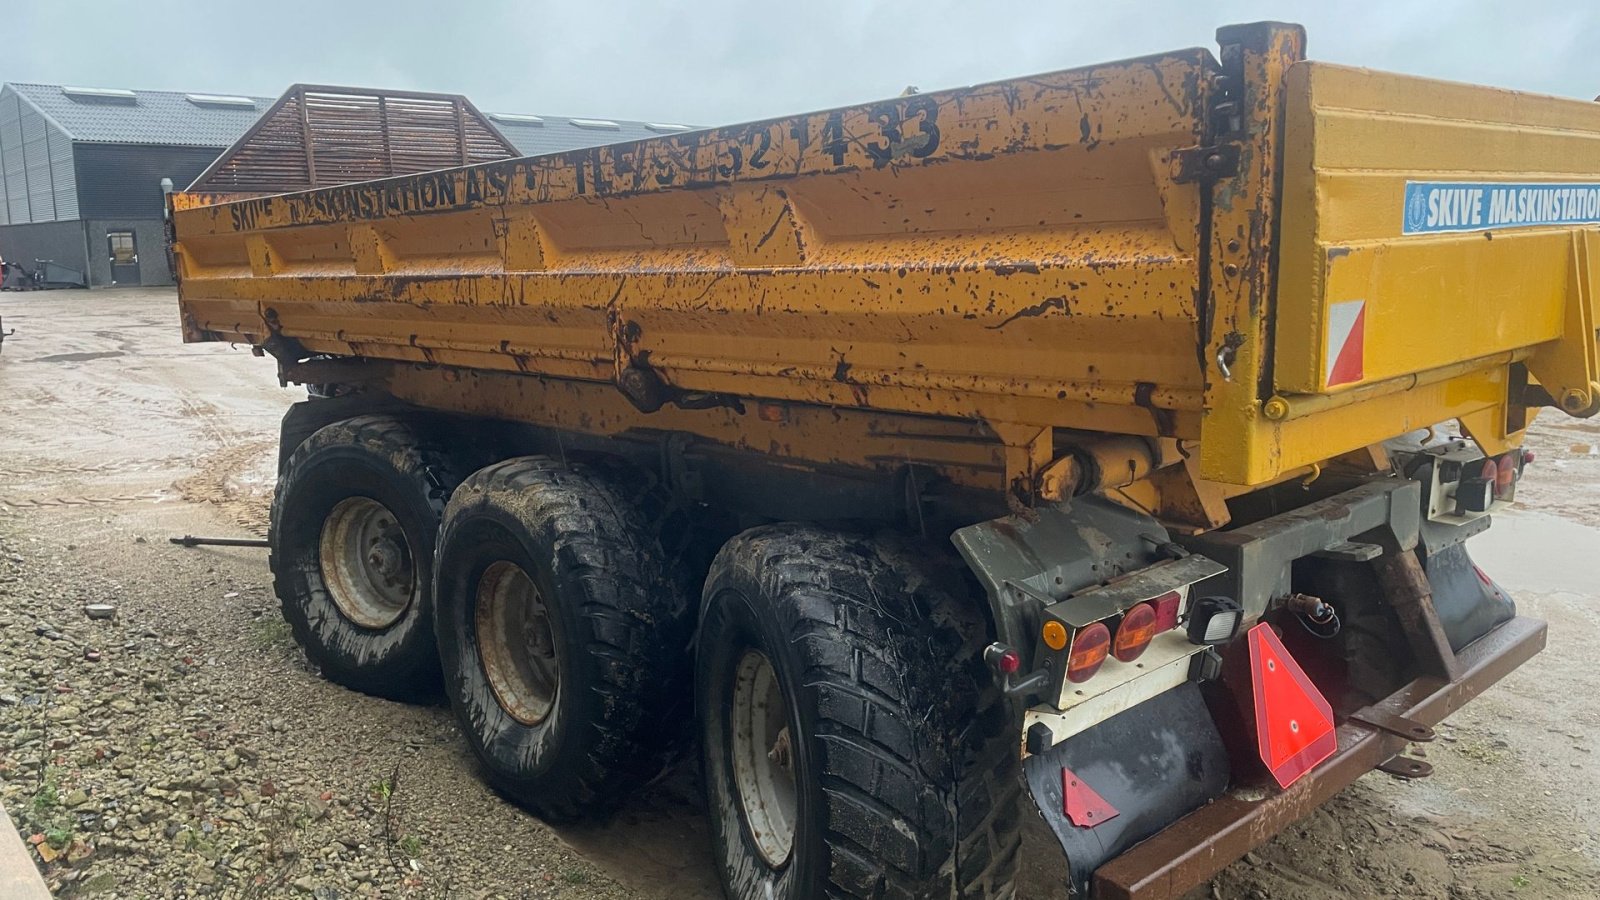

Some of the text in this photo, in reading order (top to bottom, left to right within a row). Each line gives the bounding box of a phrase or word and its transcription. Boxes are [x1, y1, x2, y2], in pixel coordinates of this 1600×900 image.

[231, 198, 273, 231] SKIVE
[867, 98, 941, 166] 33
[1427, 188, 1483, 227] SKIVE
